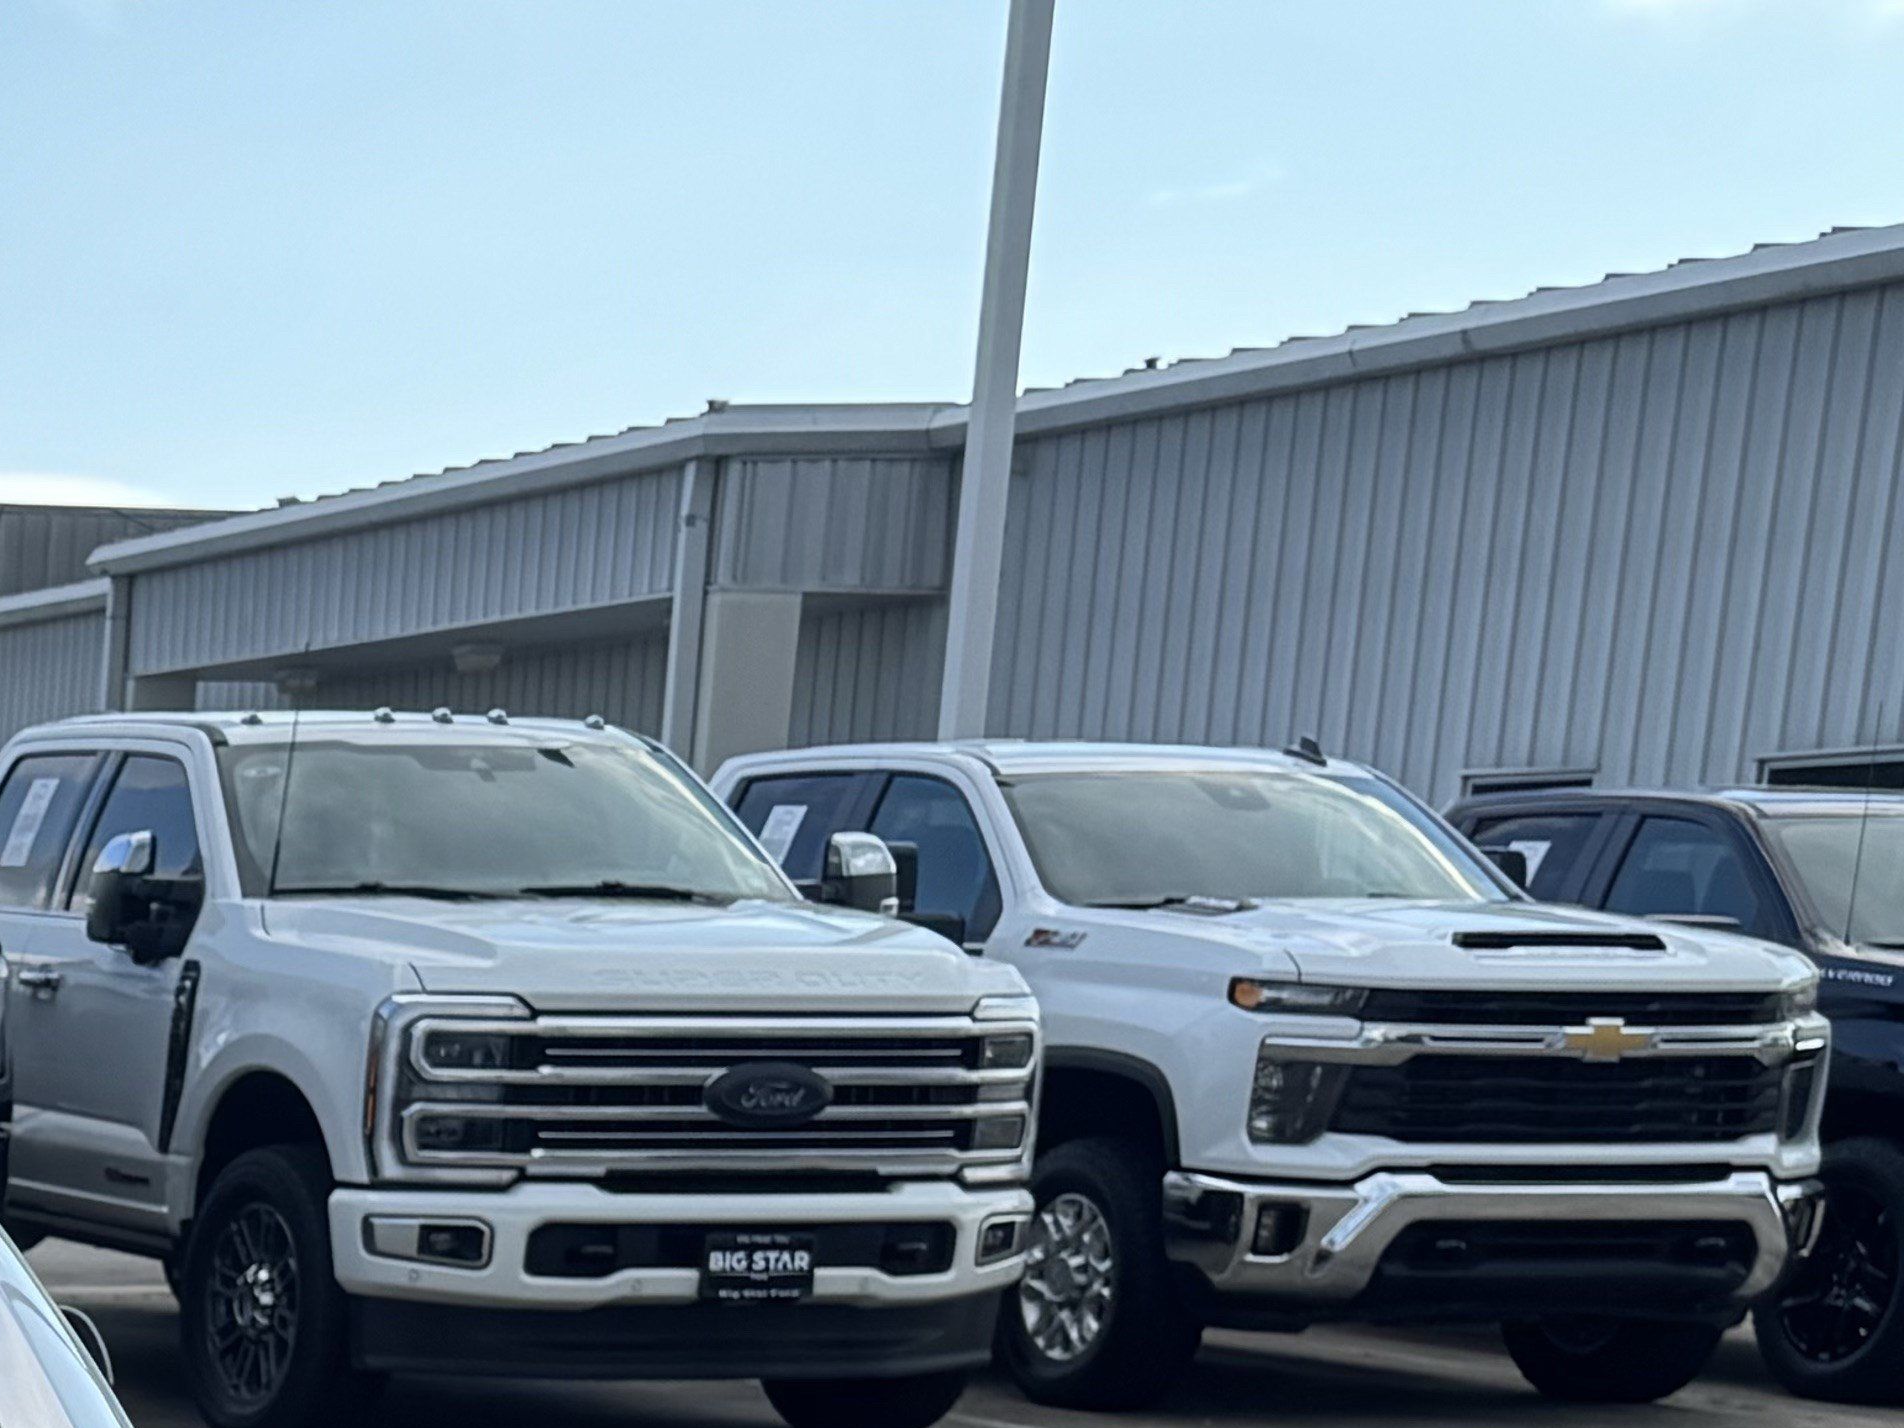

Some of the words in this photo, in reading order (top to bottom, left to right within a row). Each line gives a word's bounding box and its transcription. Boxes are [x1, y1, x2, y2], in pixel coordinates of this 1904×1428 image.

[740, 1082, 805, 1109] Ford
[708, 1249, 748, 1272] BIG
[751, 1248, 811, 1272] STAR
